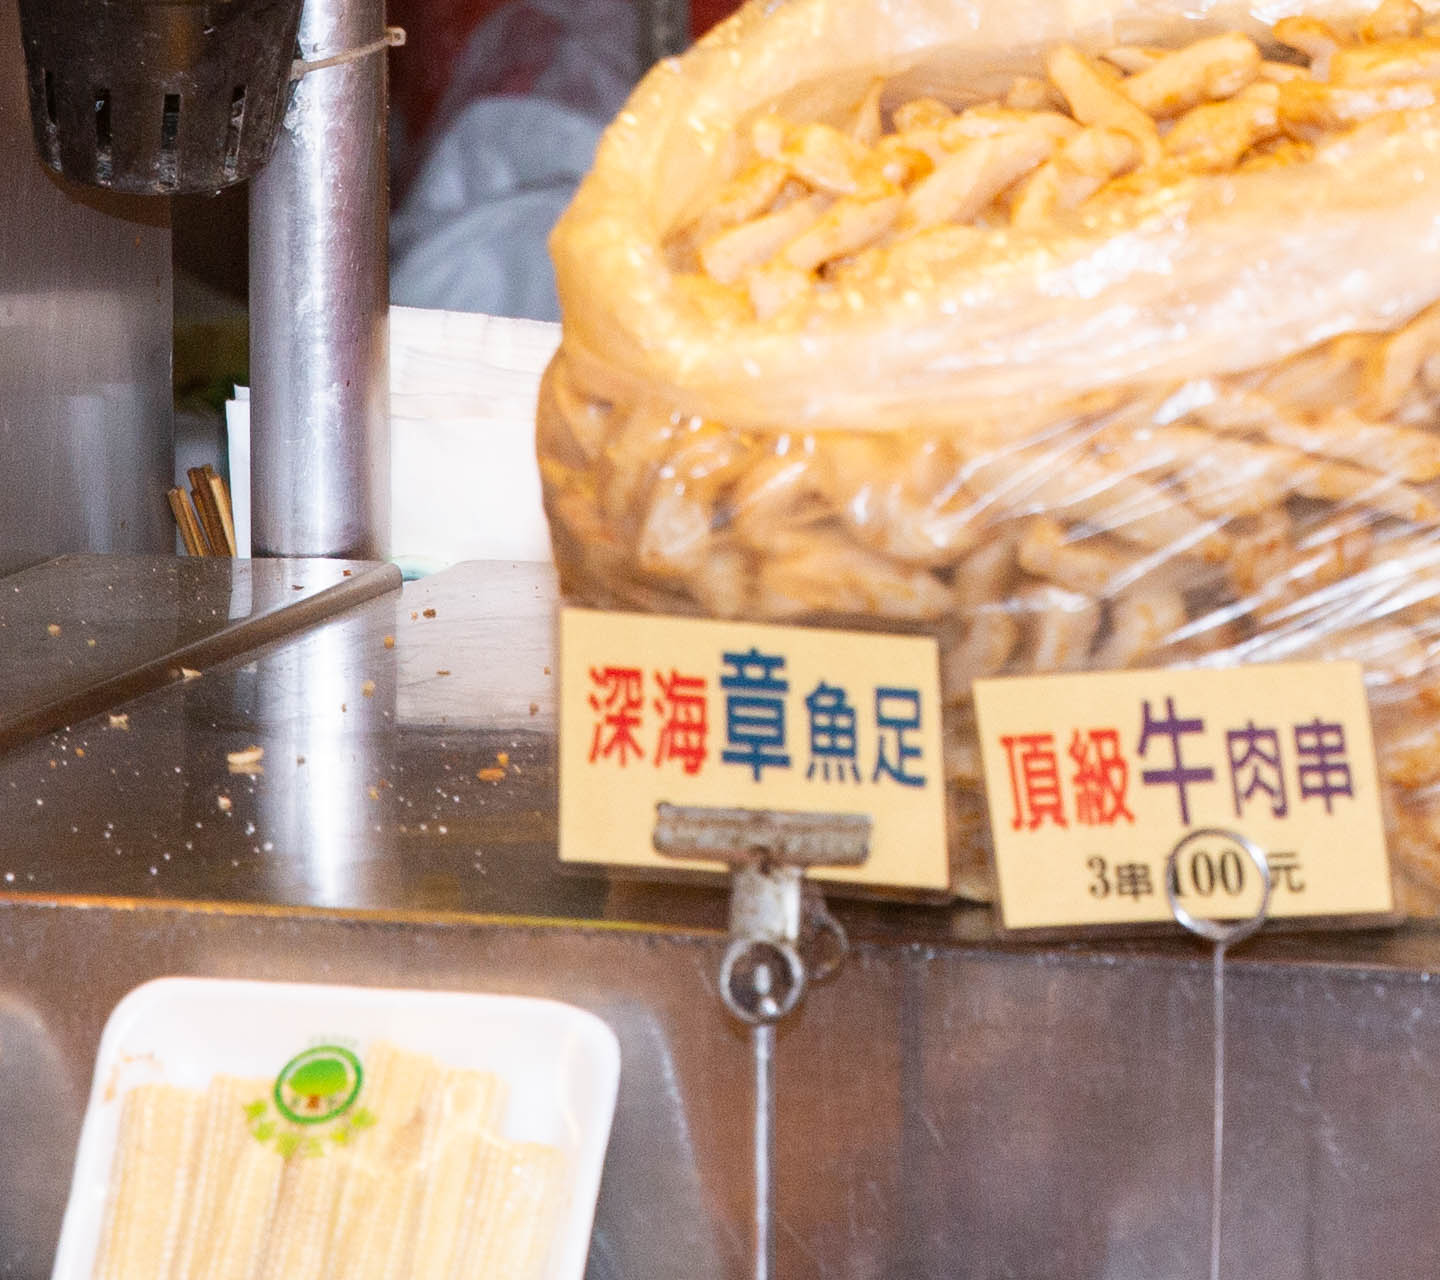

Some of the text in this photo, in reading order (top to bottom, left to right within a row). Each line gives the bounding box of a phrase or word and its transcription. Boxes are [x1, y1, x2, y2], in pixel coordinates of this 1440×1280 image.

[589, 647, 928, 787] 深海章魚足
[999, 696, 1355, 832] 頂級牛肉串
